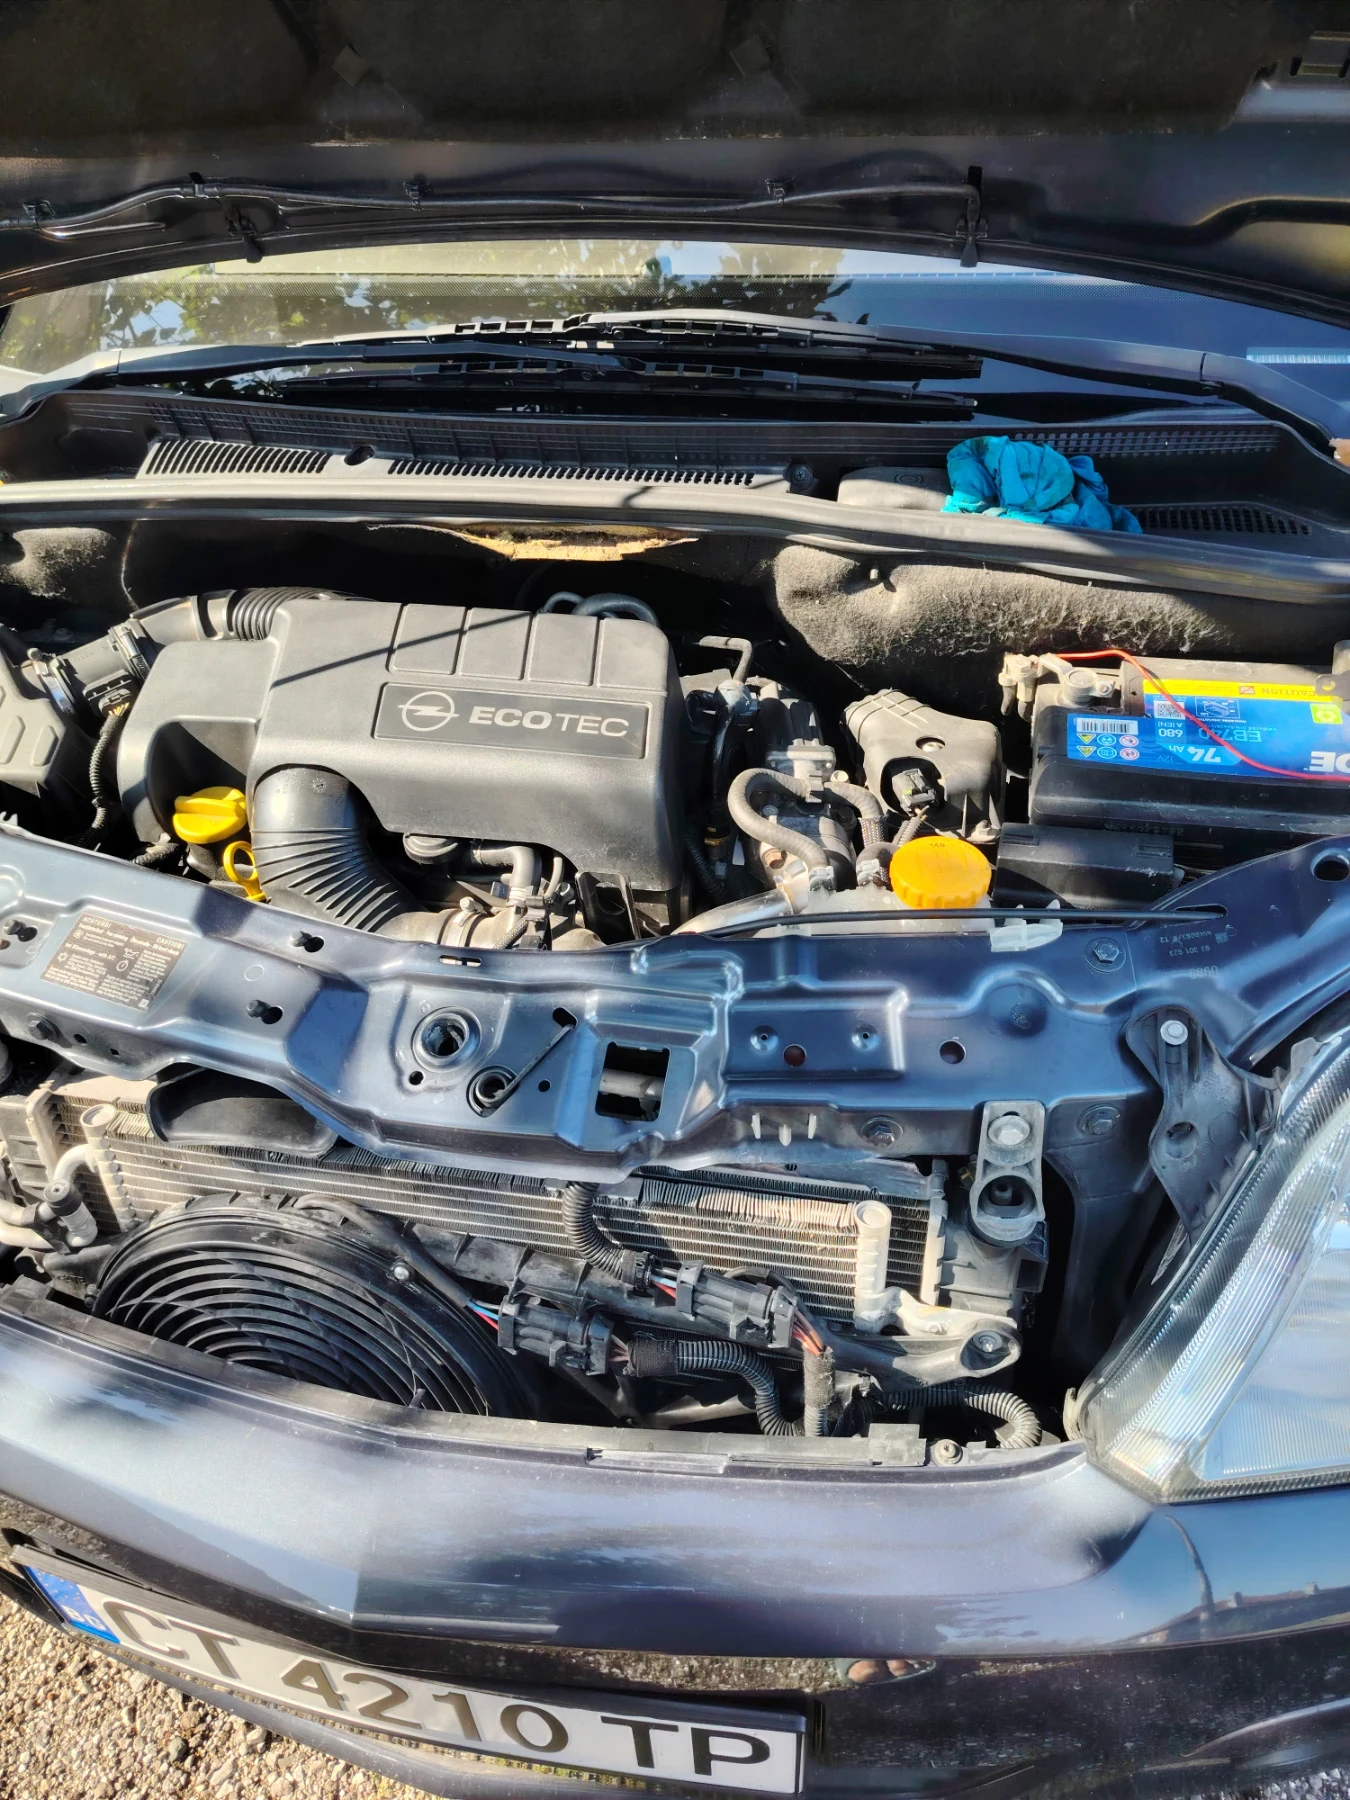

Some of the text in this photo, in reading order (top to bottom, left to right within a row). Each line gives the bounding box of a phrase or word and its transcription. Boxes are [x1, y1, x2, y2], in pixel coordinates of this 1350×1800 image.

[469, 705, 630, 738] ECOTEC
[1158, 728, 1184, 738] 680
[1156, 755, 1174, 764] 12V
[1168, 744, 1222, 763] 74 Ah
[61, 1603, 107, 1631] BG
[103, 1601, 770, 1777] CT 4210 TP
